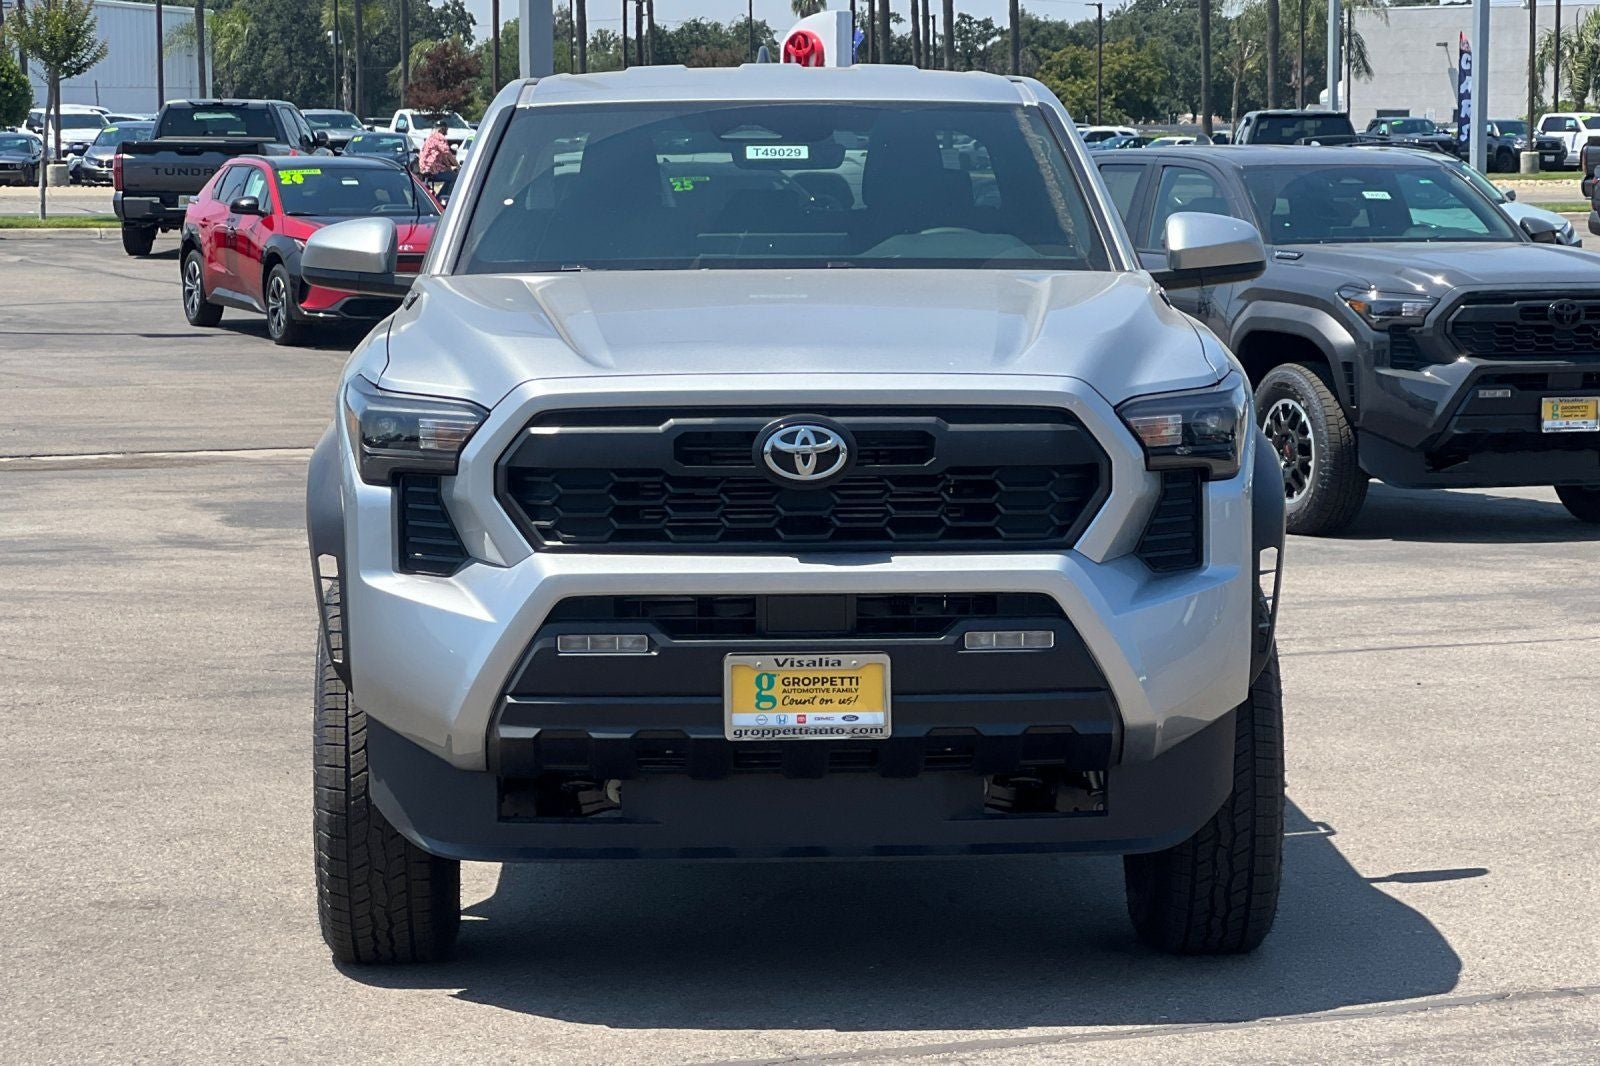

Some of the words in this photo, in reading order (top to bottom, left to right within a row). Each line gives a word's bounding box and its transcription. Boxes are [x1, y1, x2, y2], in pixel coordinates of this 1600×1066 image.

[753, 147, 801, 157] T49029
[153, 168, 215, 176] TUNDR
[672, 180, 694, 191] 25
[774, 657, 842, 668] Visalia
[781, 676, 859, 687] GROPPETTI
[781, 694, 817, 706] Count
[819, 697, 834, 705] on
[733, 725, 884, 739] groppettiauto.com
